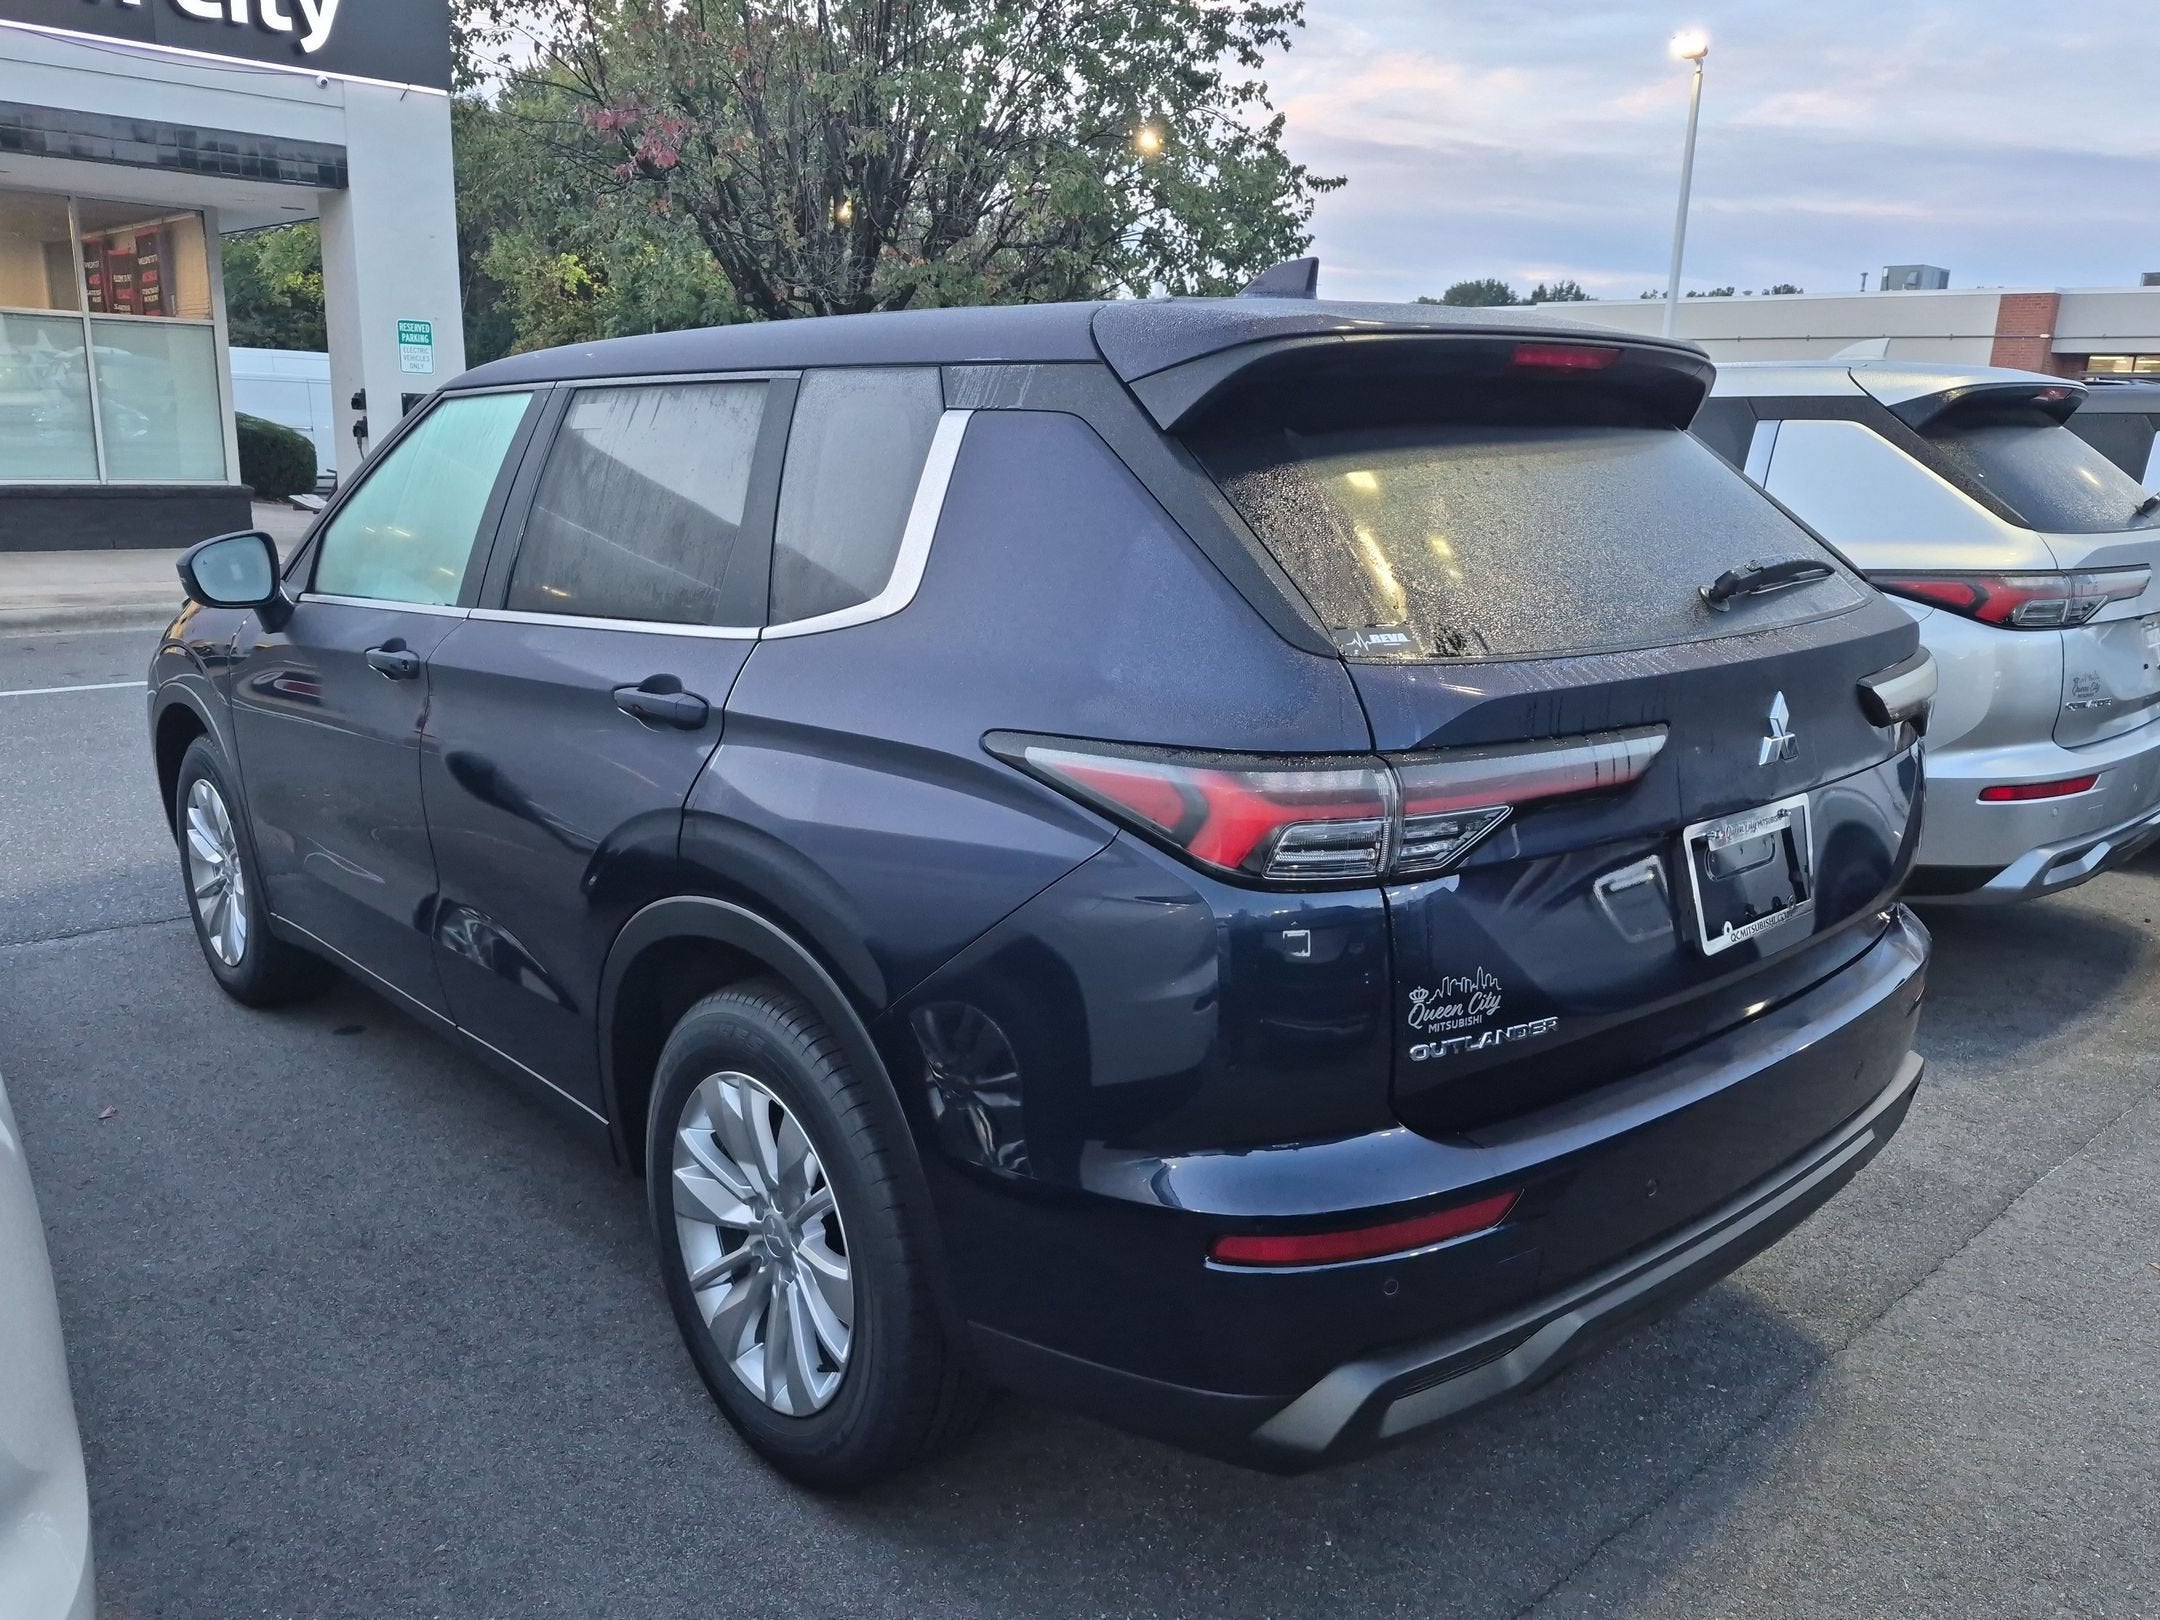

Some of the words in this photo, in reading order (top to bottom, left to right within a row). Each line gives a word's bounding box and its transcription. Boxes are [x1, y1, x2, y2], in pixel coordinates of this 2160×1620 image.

[399, 322, 430, 333] RESERVED
[401, 333, 429, 343] PARKING
[403, 346, 429, 354] ELECTRIC
[403, 354, 430, 362] VEHICLES
[1408, 1002, 1464, 1029] Queen
[1468, 991, 1501, 1016] City
[1428, 1014, 1483, 1034] MITSUBISHI
[1409, 1016, 1558, 1062] OUTLANDER
